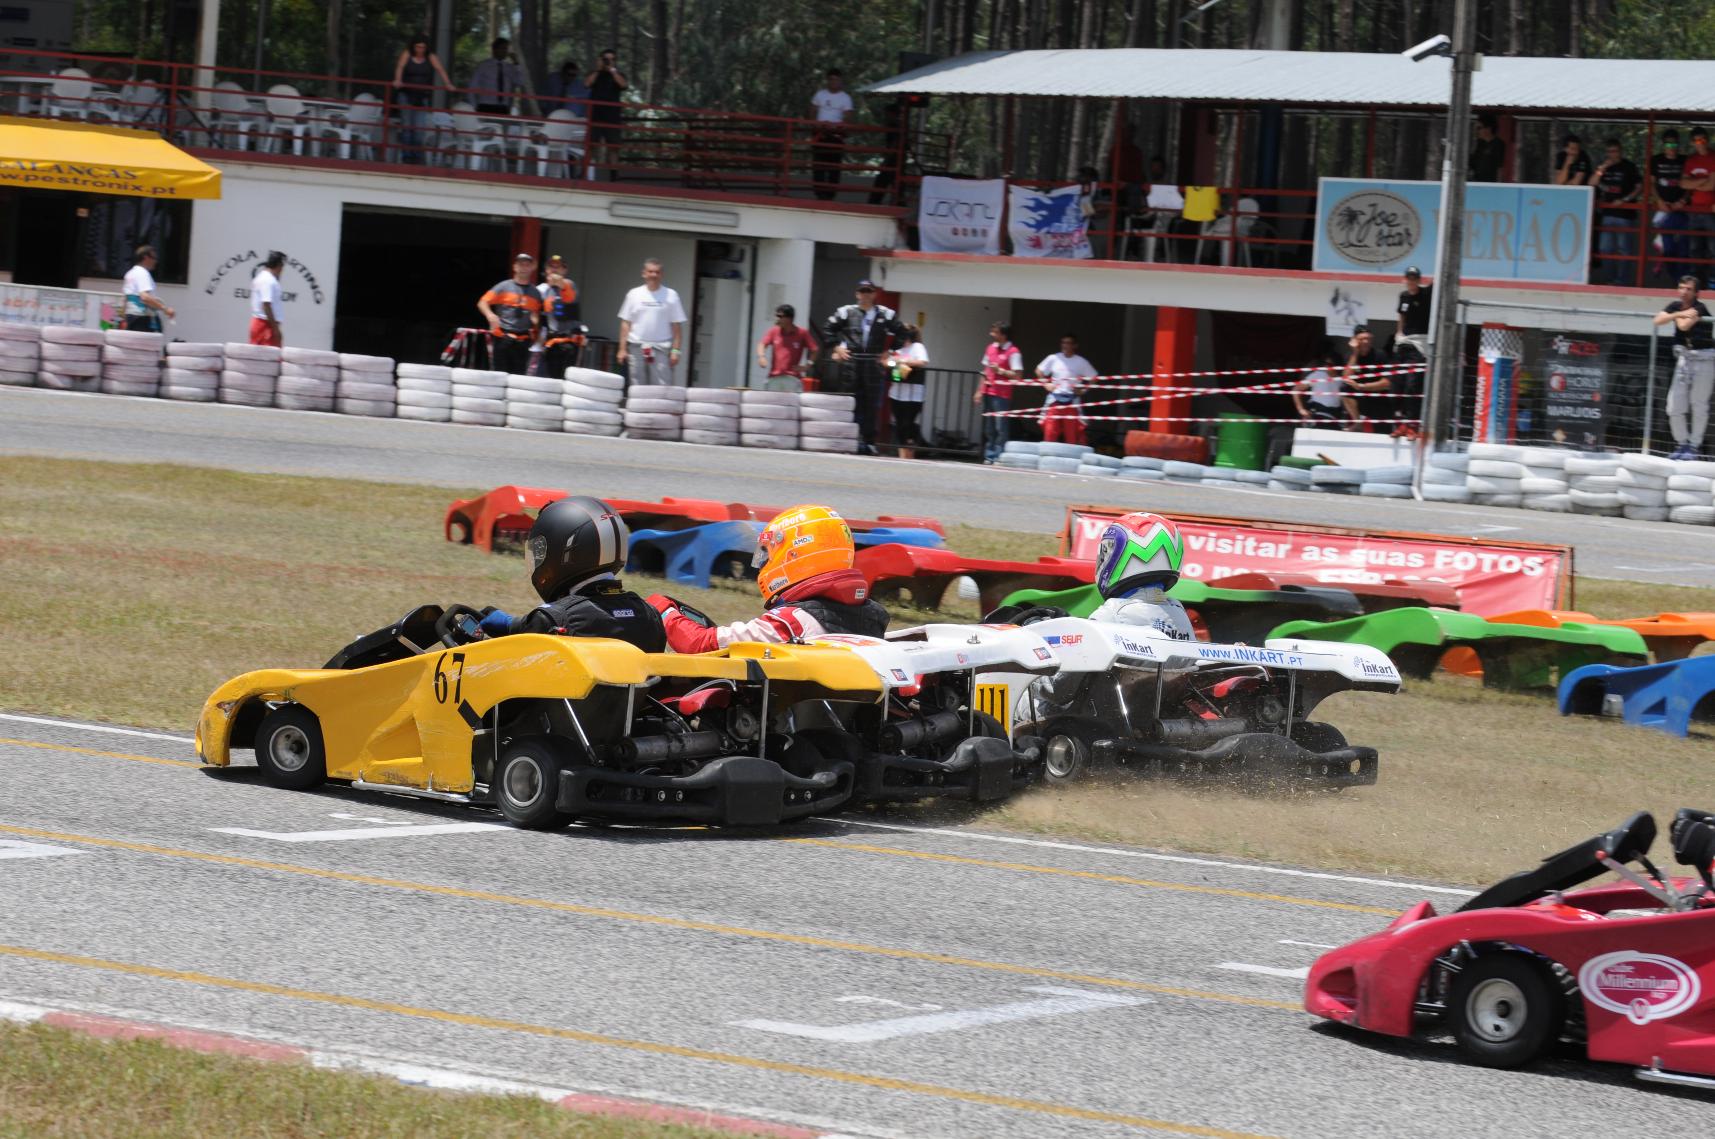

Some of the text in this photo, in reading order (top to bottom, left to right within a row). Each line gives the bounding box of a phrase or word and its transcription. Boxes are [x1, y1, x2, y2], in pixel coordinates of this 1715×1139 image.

[205, 249, 259, 296] ESCOLA
[1187, 532, 1544, 577] visitar as suas FOTOS
[434, 651, 466, 705] 67
[1198, 647, 1303, 666] WWW.INKART.PT
[1599, 974, 1679, 990] Millennium
